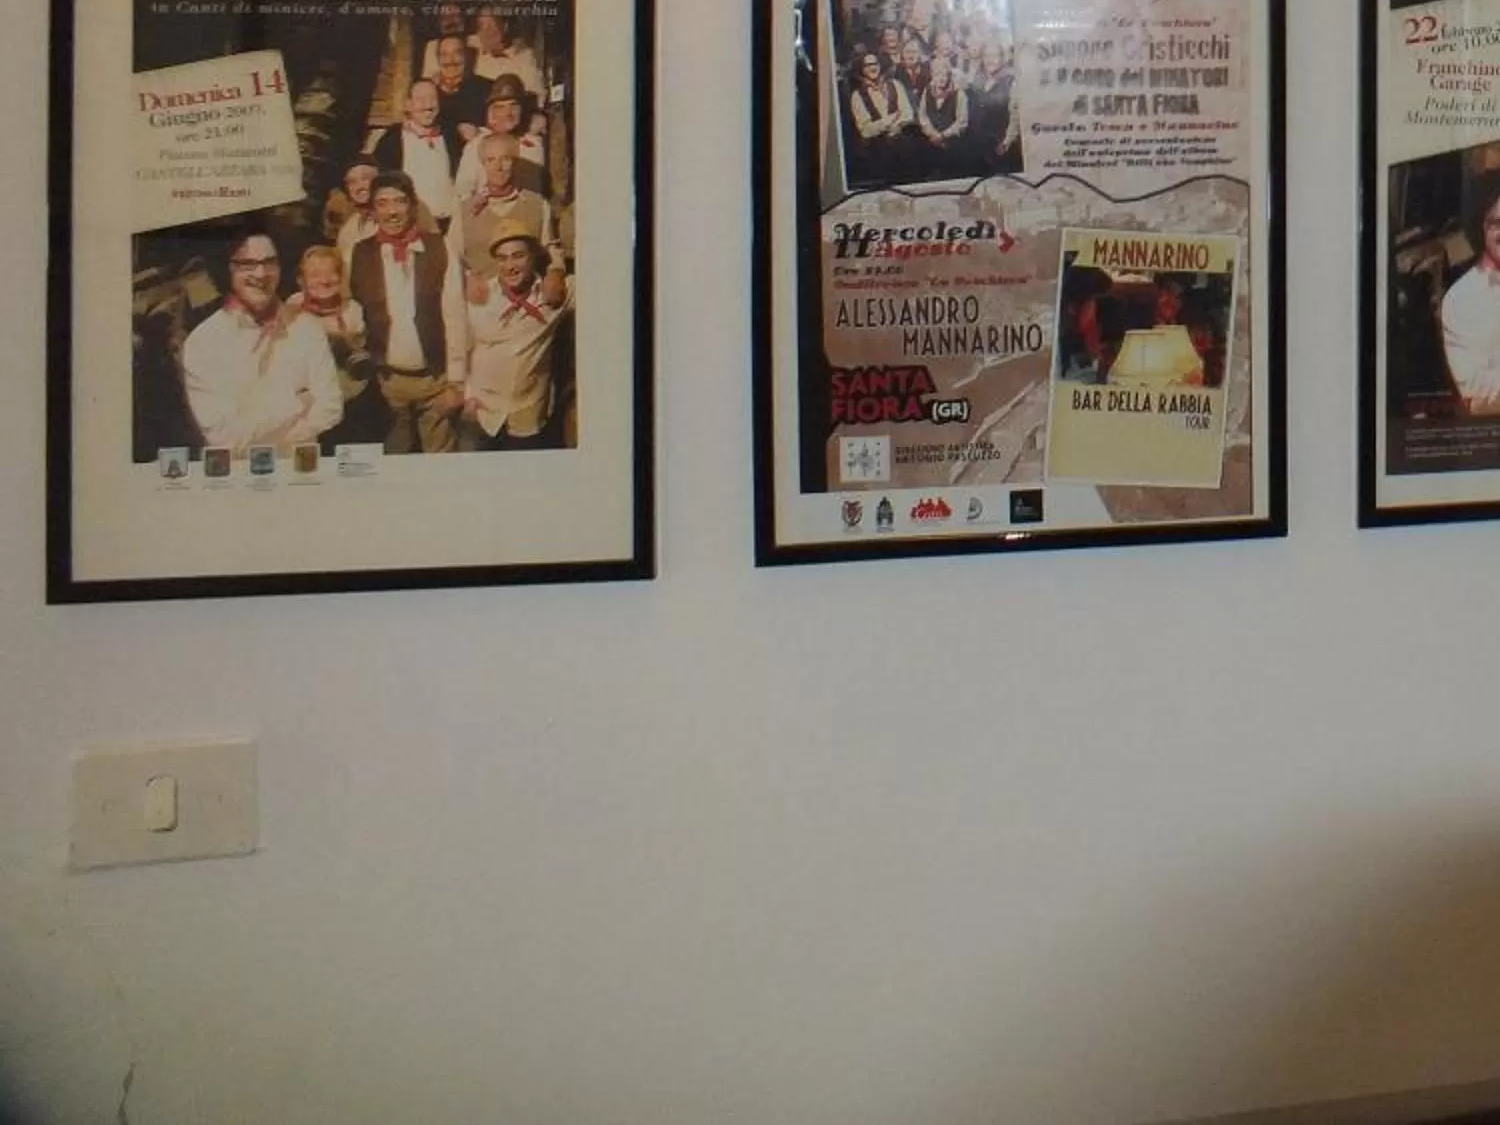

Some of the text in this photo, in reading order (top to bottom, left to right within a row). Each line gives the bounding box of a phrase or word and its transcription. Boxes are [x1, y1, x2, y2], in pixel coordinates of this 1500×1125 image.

[1404, 15, 1438, 44] 22
[1120, 34, 1231, 62] Cristicchi
[138, 68, 285, 112] Domenica 14
[1429, 75, 1492, 94] Garage
[148, 109, 221, 128] Giugno
[1092, 93, 1149, 116] SANTA
[1152, 93, 1200, 115] FIORA
[833, 219, 997, 243] Mercoledì
[1093, 239, 1210, 270] MANNARINO
[835, 294, 980, 327] ALESSANDRO
[902, 322, 1044, 356] MANNARINO
[831, 366, 932, 394] SANTA
[831, 396, 971, 421] FIORA (GR)
[1072, 390, 1212, 415] BAR DELLA RABBIA
